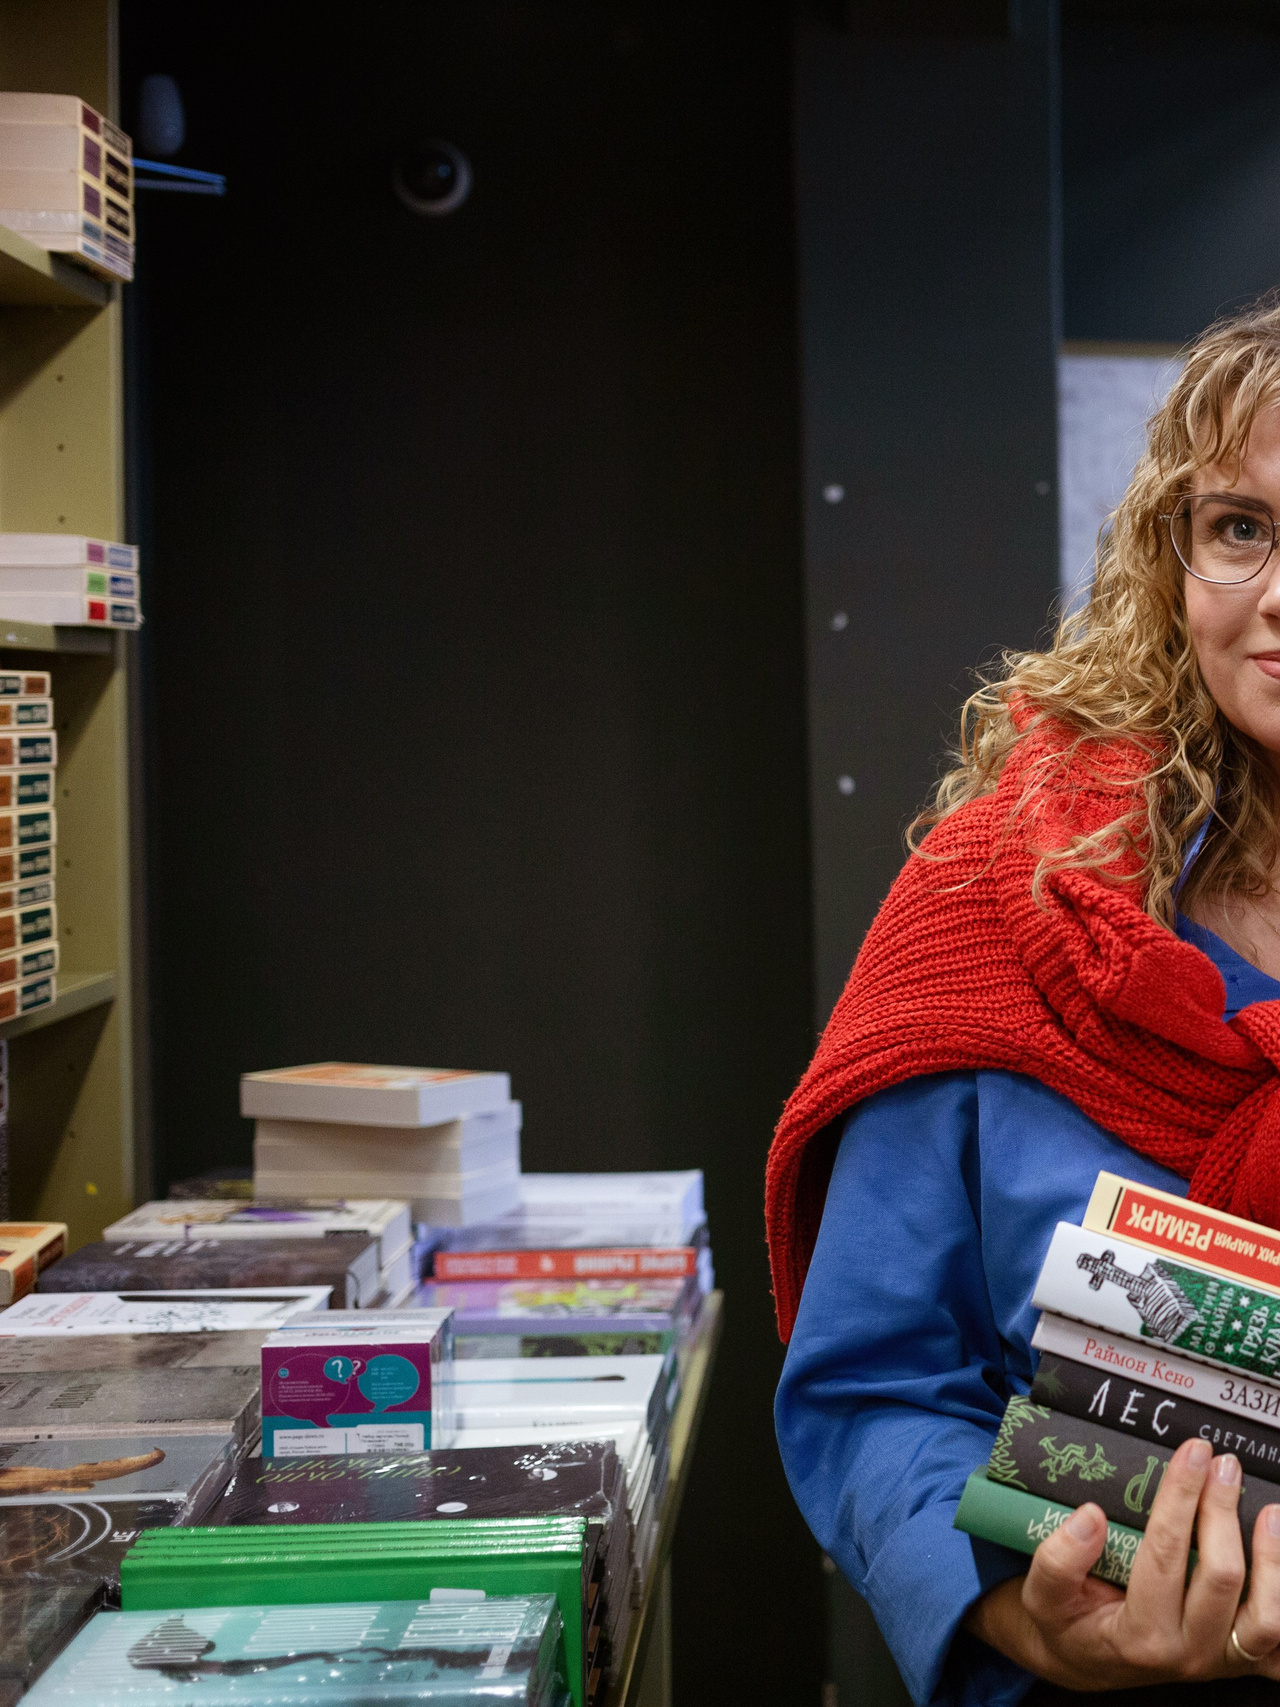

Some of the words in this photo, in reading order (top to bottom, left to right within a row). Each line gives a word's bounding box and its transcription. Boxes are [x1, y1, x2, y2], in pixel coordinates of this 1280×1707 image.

[1126, 1202, 1213, 1251] РЕМАРК
[1213, 1231, 1257, 1257] МАРИЯ
[1189, 1280, 1220, 1349] МАРТИН
[1238, 1305, 1270, 1357] ГРЯЗЬ
[1083, 1337, 1147, 1374] Раймон
[1151, 1360, 1195, 1389] Кено
[1088, 1378, 1176, 1437] ЛЕС
